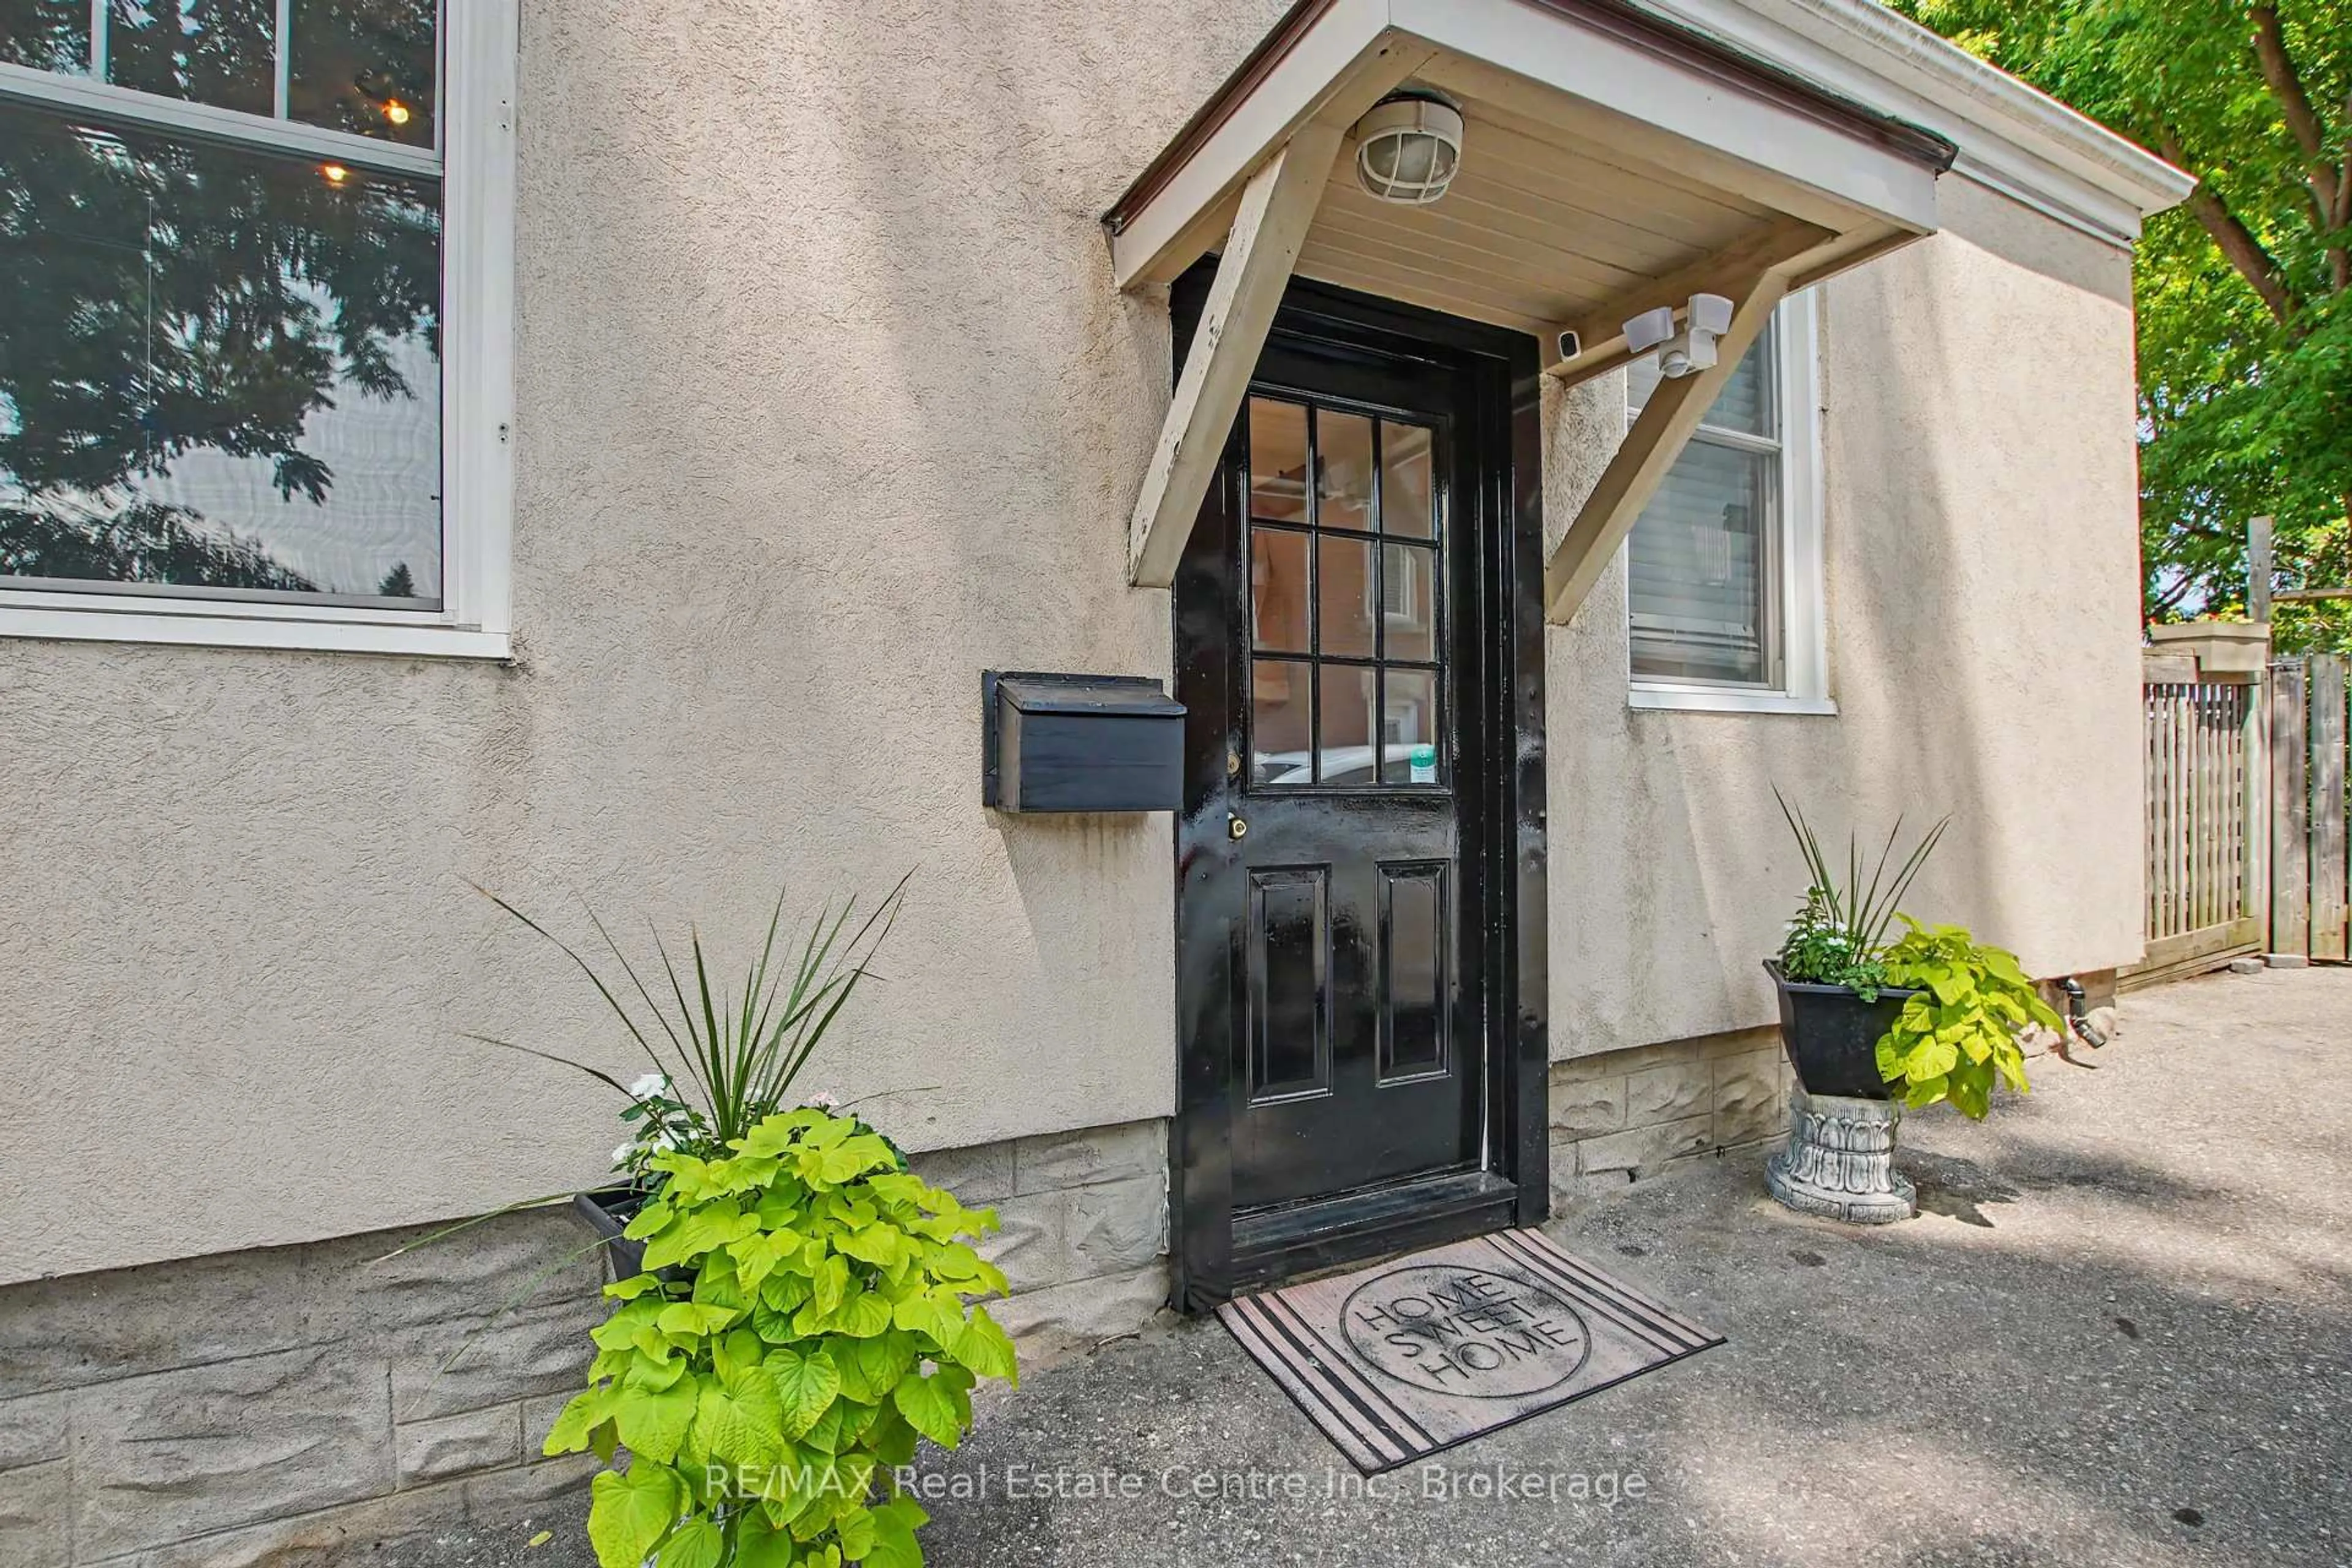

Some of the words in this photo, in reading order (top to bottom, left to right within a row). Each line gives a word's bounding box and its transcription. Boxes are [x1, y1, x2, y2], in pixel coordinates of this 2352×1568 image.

[1354, 1275, 1506, 1331] HOME
[1384, 1297, 1536, 1357] SWEET
[1418, 1319, 1579, 1387] HOME
